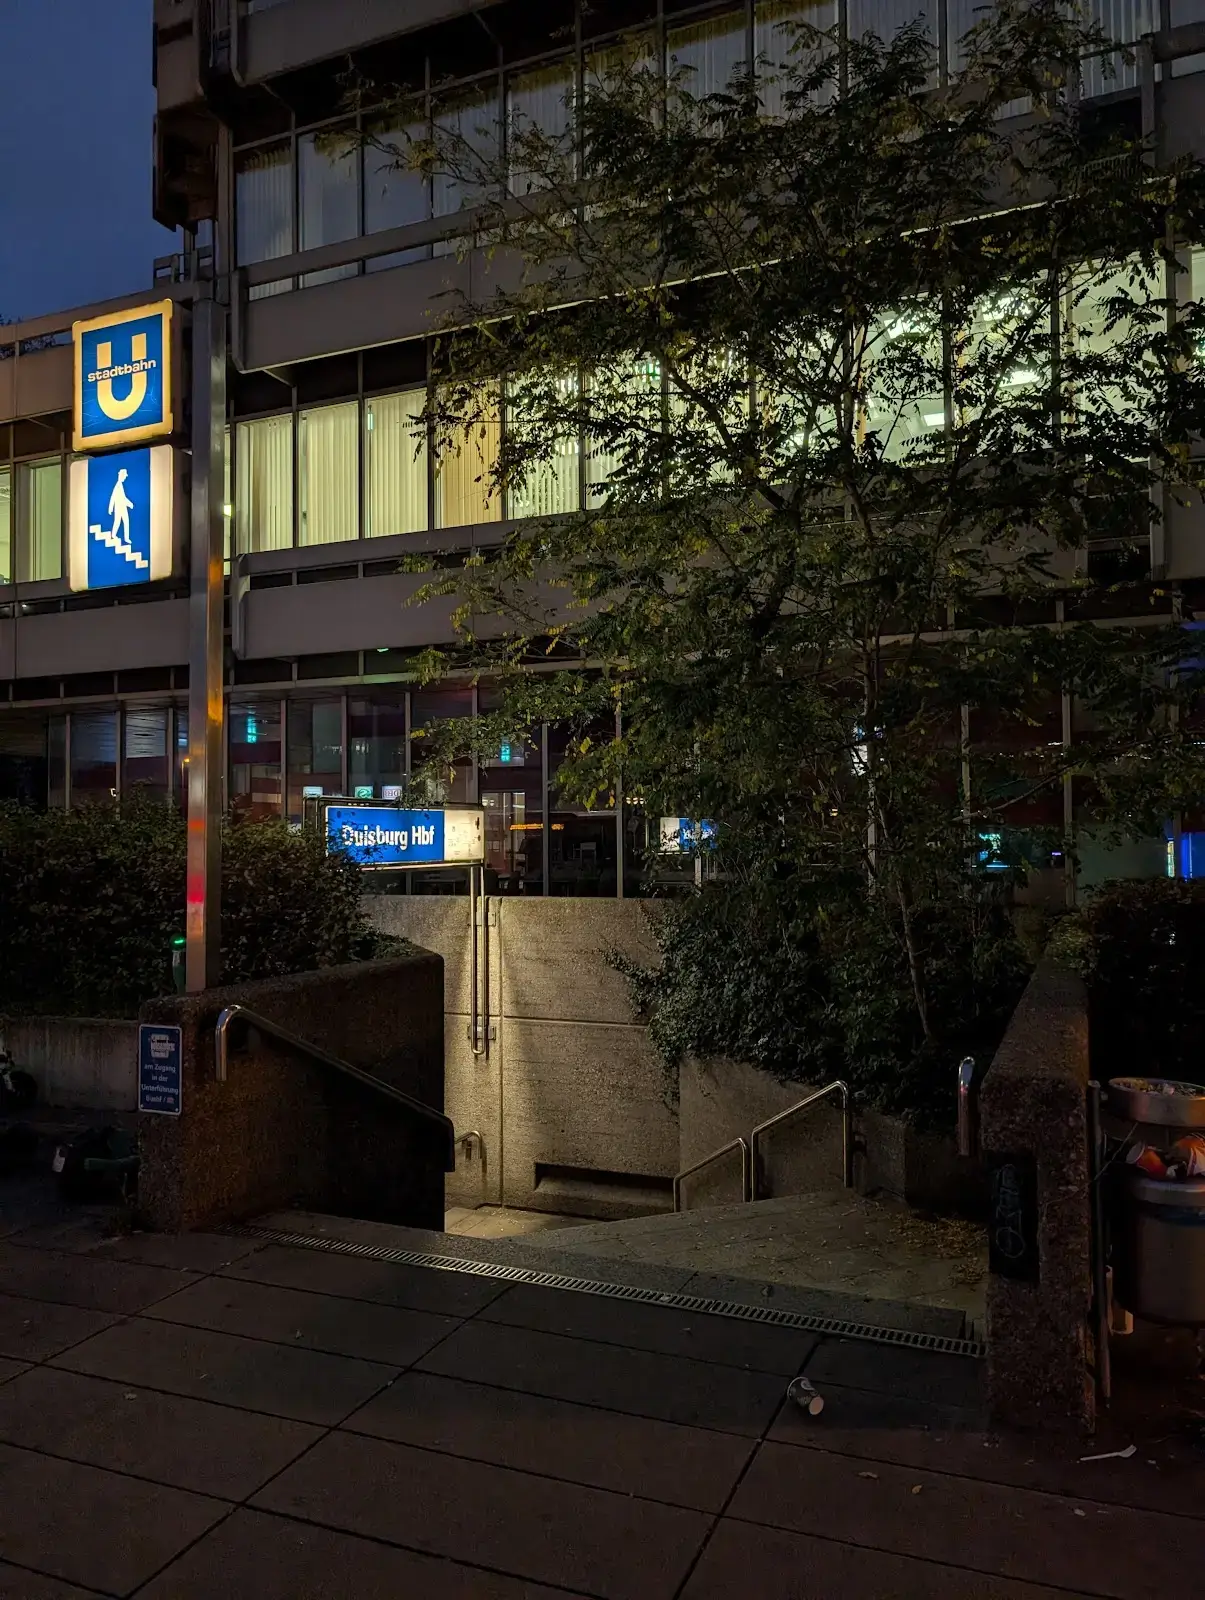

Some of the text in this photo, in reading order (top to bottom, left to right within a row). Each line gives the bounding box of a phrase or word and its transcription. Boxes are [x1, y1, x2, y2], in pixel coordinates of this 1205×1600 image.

[87, 359, 157, 383] stadtbahn
[97, 333, 147, 420] U
[342, 824, 435, 850] Duisburg Hbf
[154, 1063, 176, 1074] Zugang
[158, 1074, 169, 1082] der
[141, 1084, 178, 1096] Unterführung
